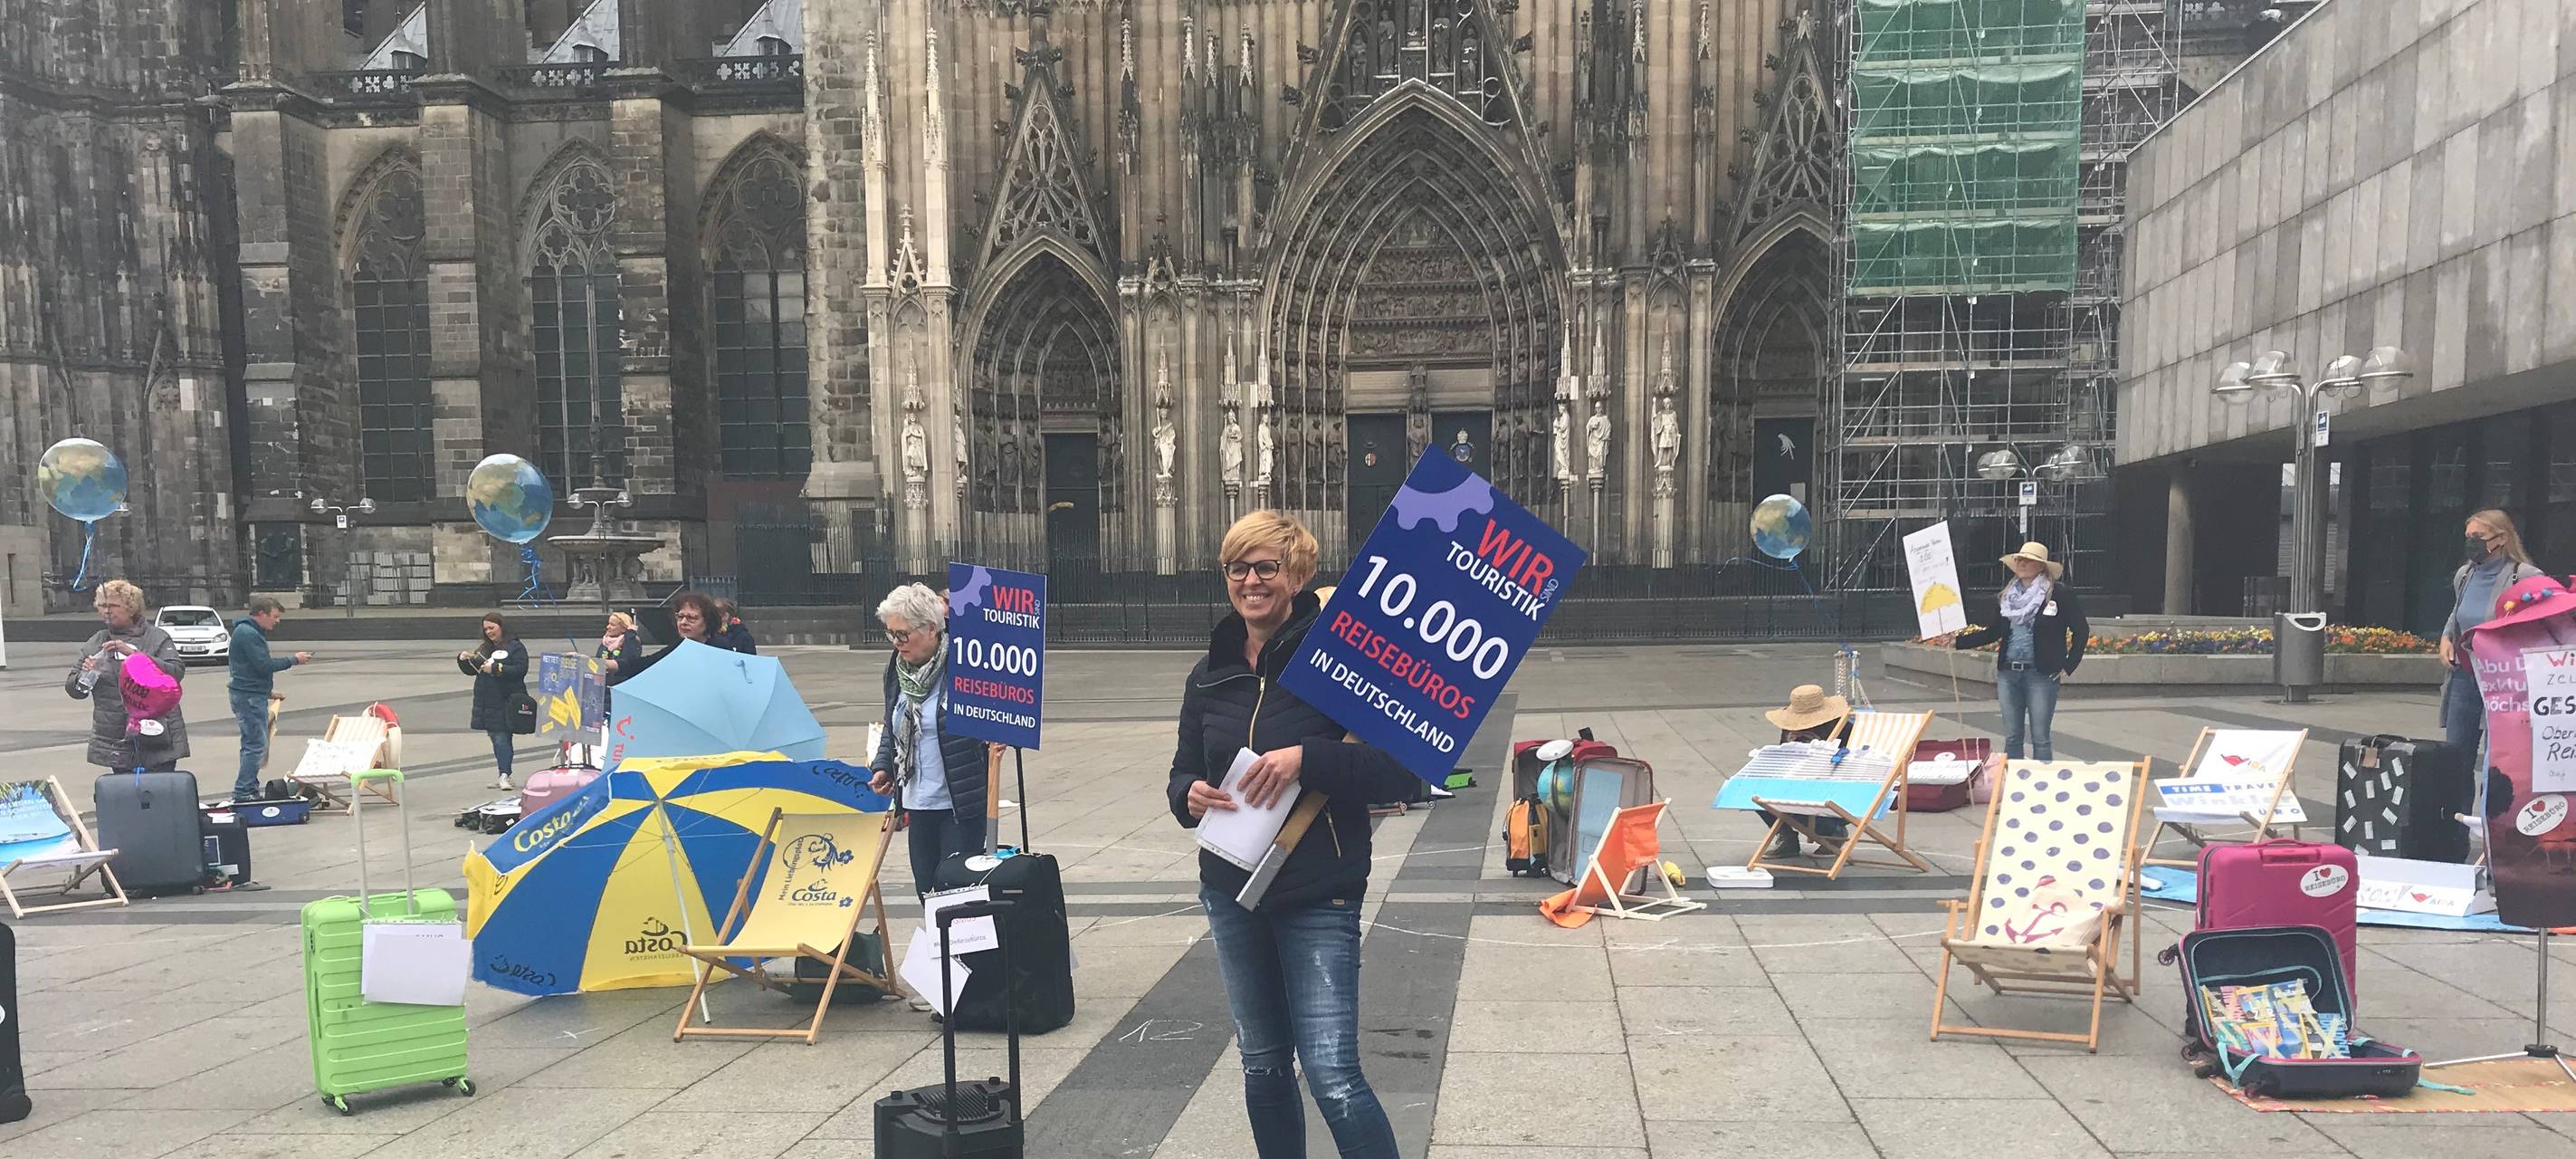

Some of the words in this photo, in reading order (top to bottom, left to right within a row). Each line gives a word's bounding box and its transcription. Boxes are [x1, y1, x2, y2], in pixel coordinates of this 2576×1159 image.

[1477, 517, 1555, 597] WIR
[1446, 541, 1547, 621] TOURISTIK
[1540, 578, 1559, 602] SIND
[993, 585, 1035, 615] WIR
[983, 608, 1040, 629] TOURISTIK
[1358, 554, 1510, 681] 10.000
[953, 637, 1037, 677] 10.000
[1331, 610, 1477, 721] REISEBÜROS
[2476, 657, 2510, 674] Abu
[954, 676, 1035, 704] REISEBÜROS
[1309, 647, 1334, 674] IN
[1330, 660, 1456, 754] DEUTSCHLAND
[953, 703, 965, 716] IN
[966, 705, 1036, 729] DEUTSCHLAND
[2171, 785, 2212, 794] TIME
[2225, 782, 2281, 792] TRAVE
[513, 810, 571, 852] Costa
[2523, 800, 2566, 833] REISEBÜRO
[778, 883, 790, 901] Mein
[792, 888, 837, 902] Costa
[2304, 875, 2347, 892] REISEBÜRO
